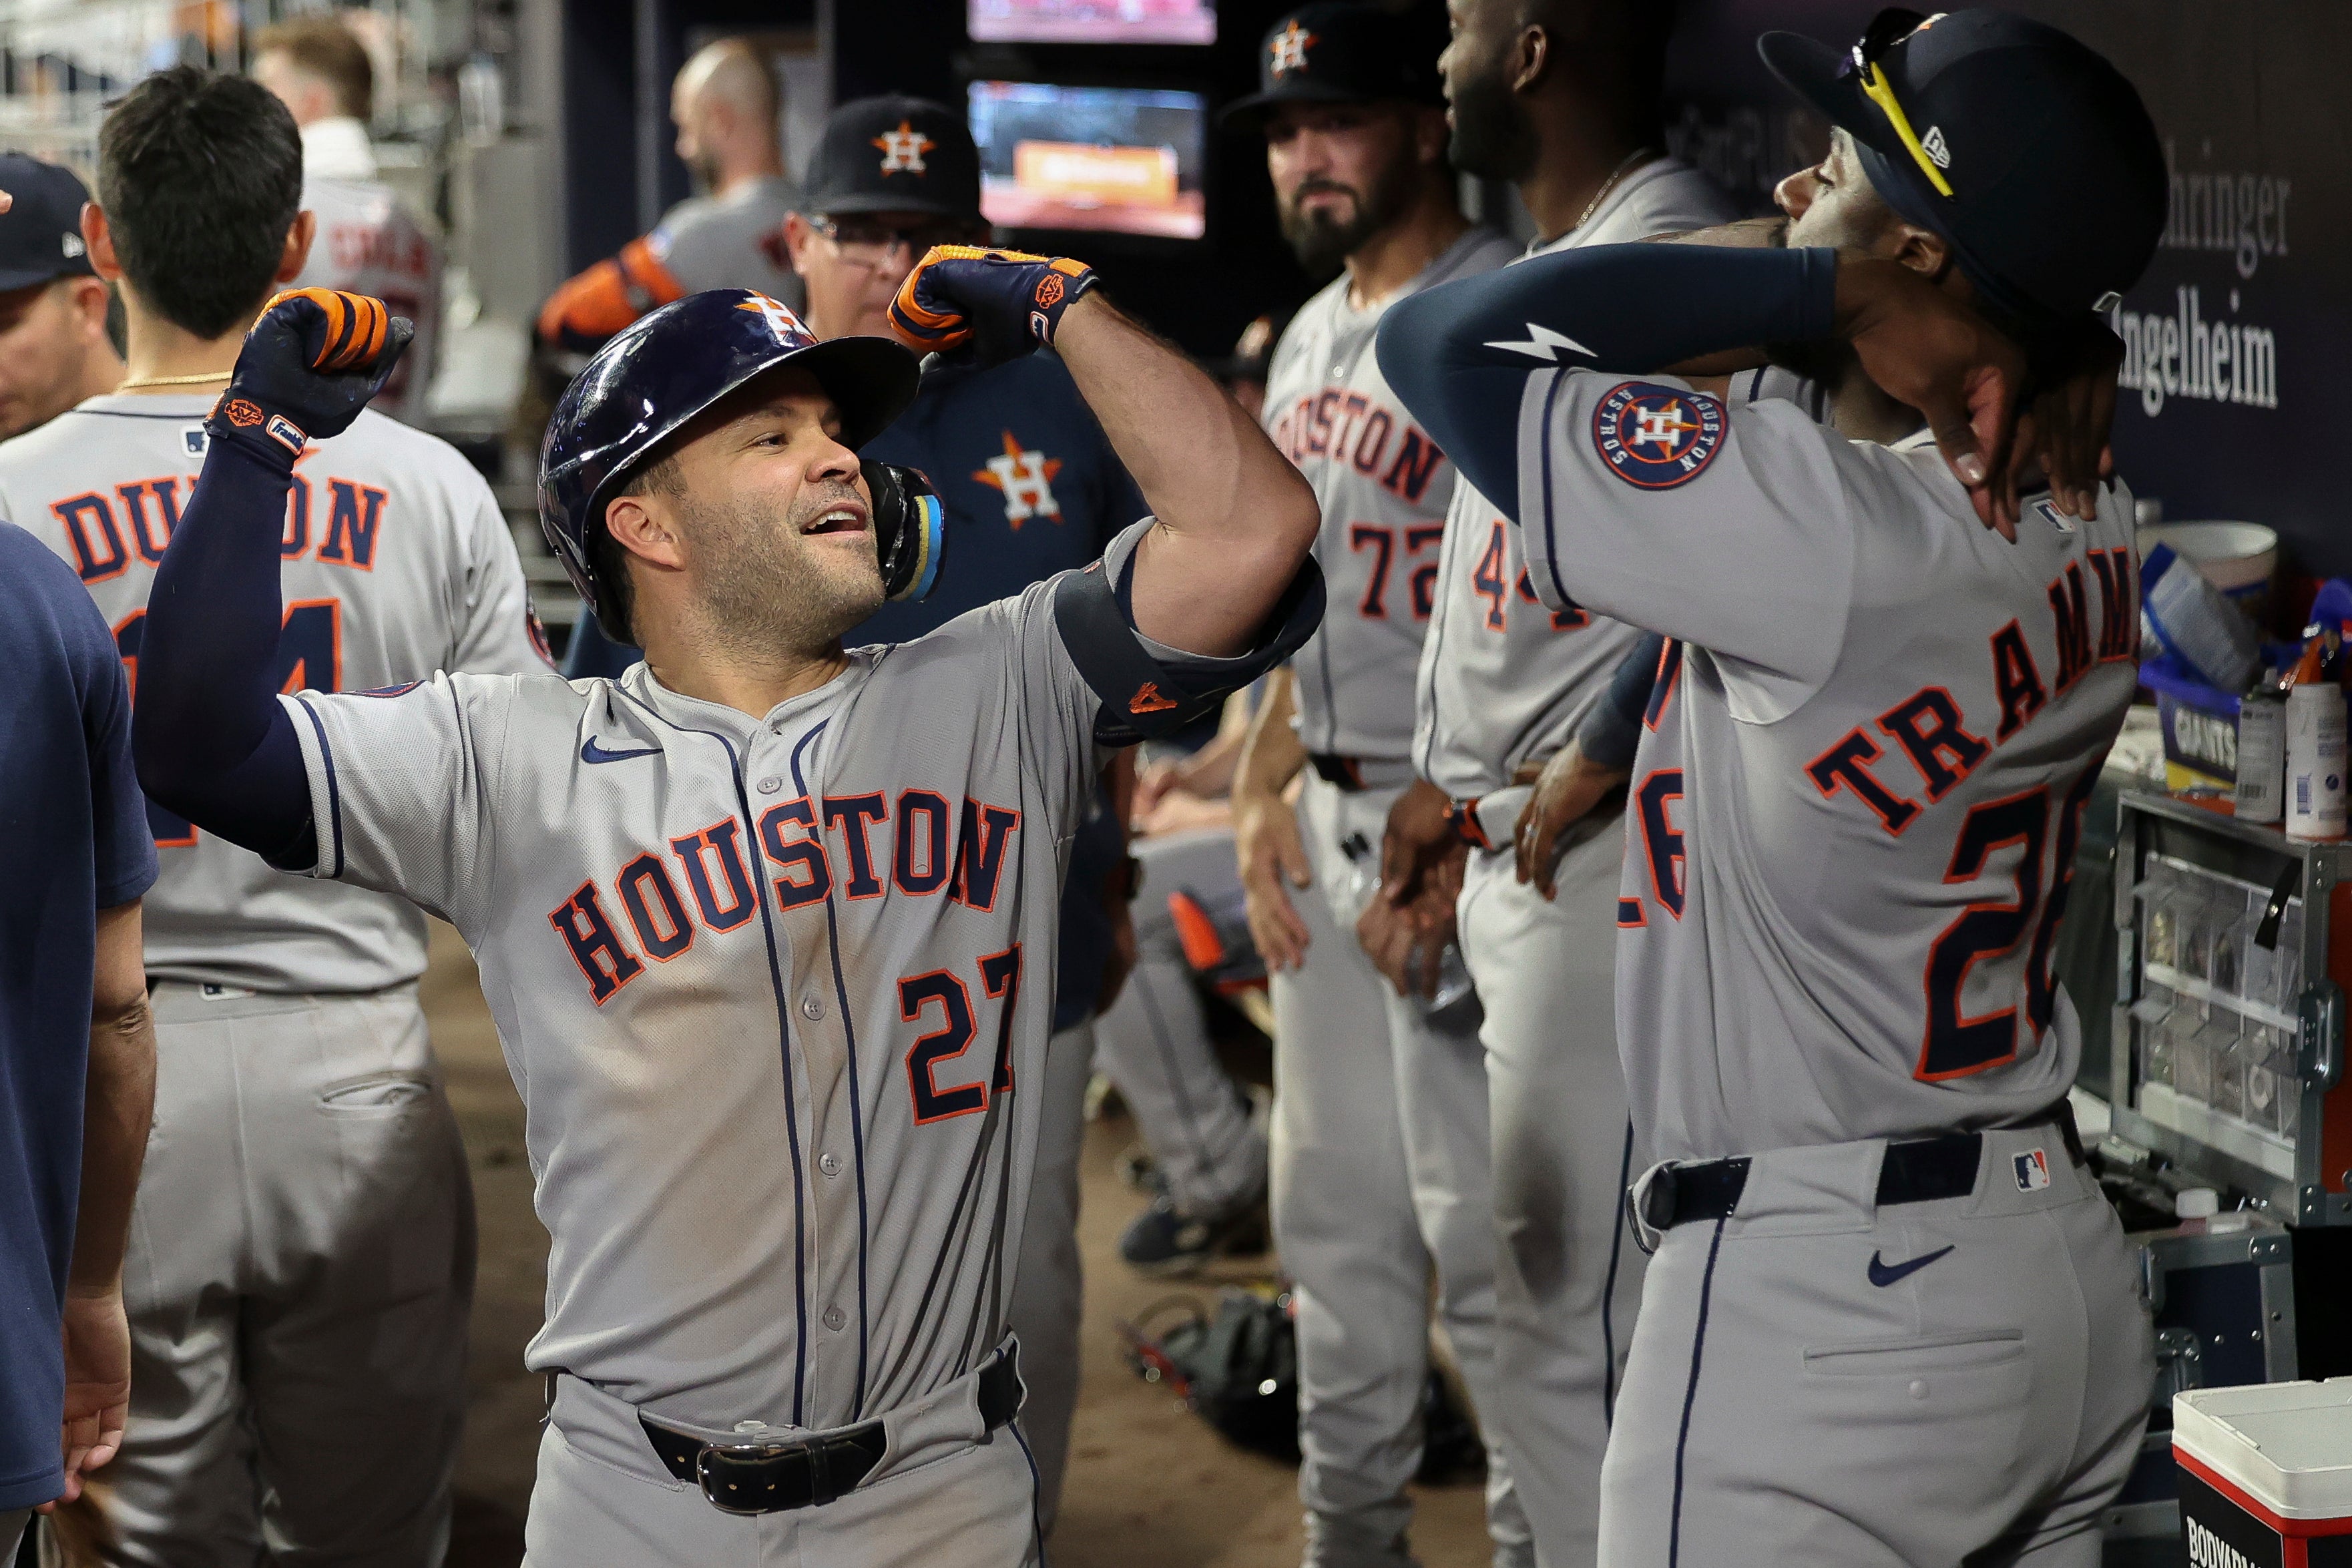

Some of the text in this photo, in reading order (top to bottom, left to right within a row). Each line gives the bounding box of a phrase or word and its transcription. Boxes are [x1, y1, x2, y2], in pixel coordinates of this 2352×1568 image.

[1600, 389, 1635, 465] ASTROS
[50, 472, 389, 585] DUN
[1803, 546, 2140, 838] TRAMM
[547, 788, 1021, 1007] HOUSTON
[897, 941, 1023, 1126] 27
